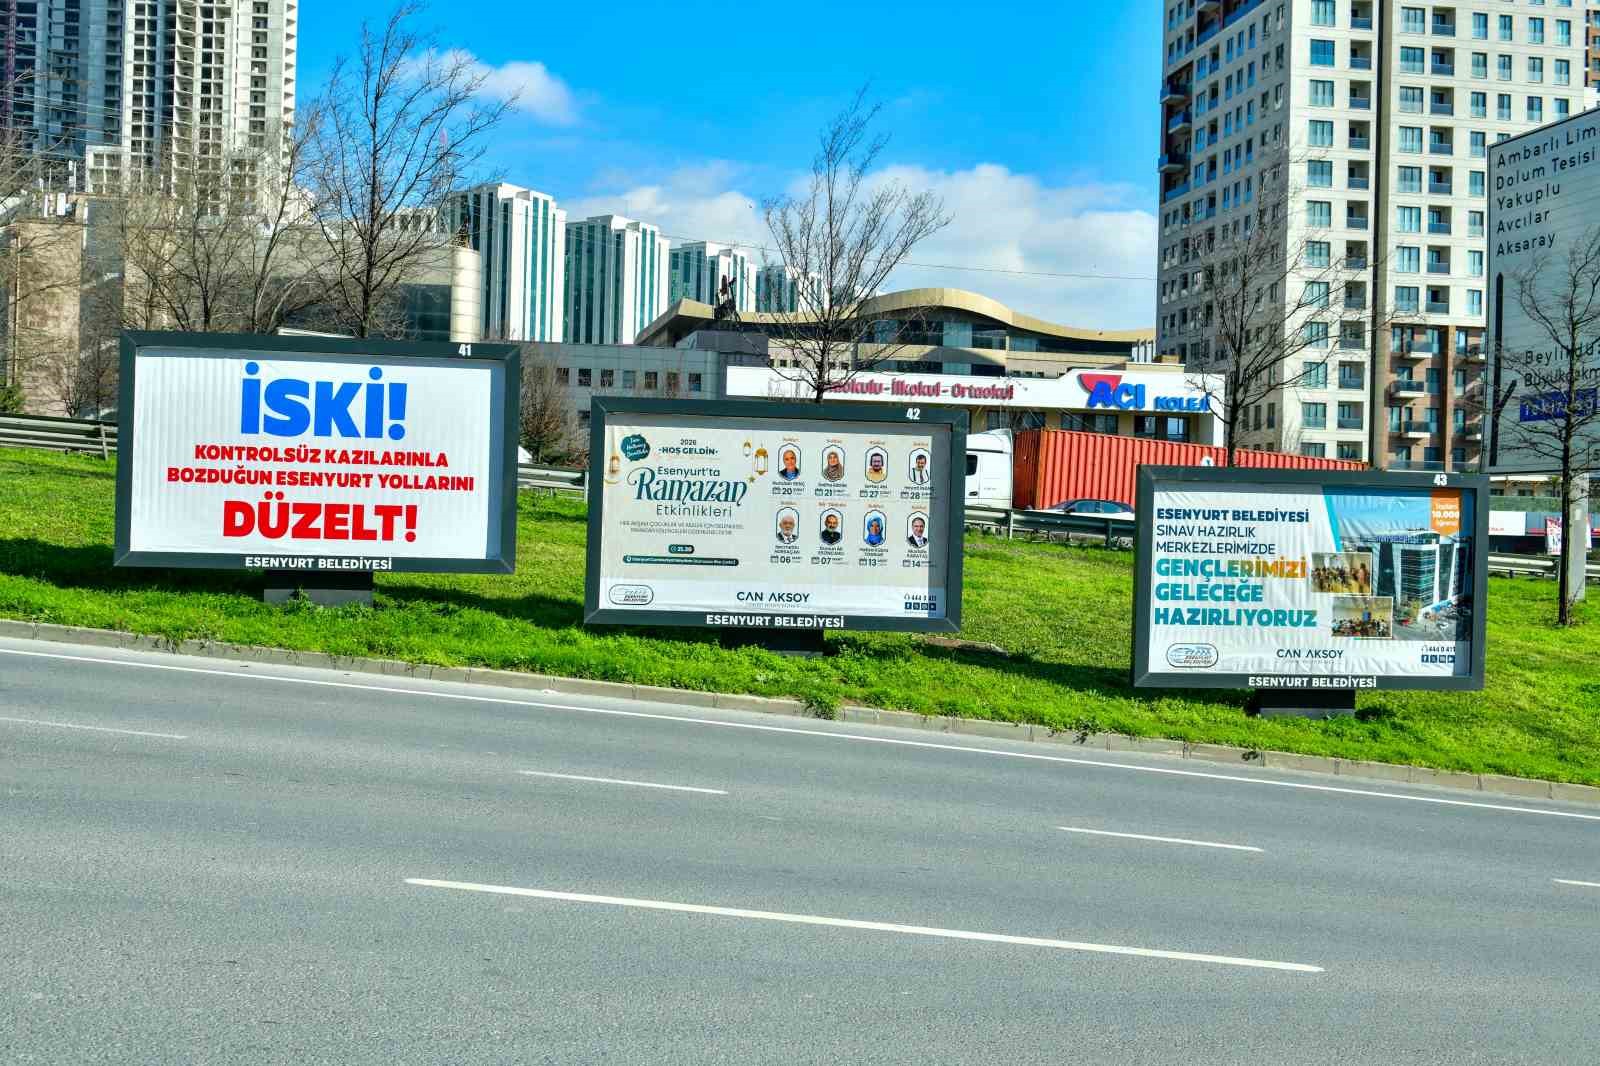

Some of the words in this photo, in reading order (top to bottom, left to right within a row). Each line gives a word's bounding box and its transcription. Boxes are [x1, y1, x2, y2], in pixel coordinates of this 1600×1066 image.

[1497, 136, 1560, 169] Ambarlı
[1566, 125, 1600, 146] Lim
[1496, 165, 1546, 191] Dolum
[1552, 146, 1596, 173] Tesisi
[1498, 183, 1561, 211] Yakuplu
[1496, 210, 1550, 234] Avcılar
[1496, 232, 1557, 257] Aksaray
[458, 343, 471, 356] 41
[951, 383, 1014, 401] Ortaokul
[240, 361, 408, 441] İSKİ!
[905, 407, 921, 421] 42
[194, 444, 321, 464] KONTROLSÜZ
[324, 448, 449, 468] KAZILARINLA
[167, 465, 273, 485] BOZDUĞUN
[276, 471, 373, 489] ESENYURT
[377, 474, 474, 492] YOLLARINI
[1433, 474, 1449, 486] 43
[627, 466, 748, 507] Ramazan
[782, 487, 793, 495] 20
[824, 489, 833, 497] 21
[870, 490, 879, 498] 27
[910, 492, 921, 500] 28
[222, 491, 418, 543] DÜZELT!
[656, 504, 733, 518] Etkinlikleri
[1156, 508, 1229, 521] ESENYURT
[1231, 507, 1310, 523] BELEDİYESİ
[1156, 525, 1194, 536] SINAV
[1197, 526, 1256, 538] HAZIRLIK
[1156, 541, 1276, 555] MERKEZLERİMİZDE
[245, 556, 315, 569] ESENYURT
[317, 556, 393, 571] BELEDİYESİ
[821, 557, 832, 565] 07
[1156, 557, 1308, 582] GENÇLERİMİZİ
[736, 592, 763, 601] CAN
[768, 592, 810, 603] AKSOY
[1155, 578, 1264, 602] GELECEĞE
[706, 614, 770, 626] ESENYURT
[774, 614, 845, 628] BELEDİYESİ
[1154, 607, 1318, 628] HAZIRLIYORUZ
[1276, 649, 1301, 658] CAN
[1305, 649, 1344, 659] AKSOY
[1248, 676, 1309, 688] ESENYURT
[1312, 675, 1377, 689] BELEDİYESİ
